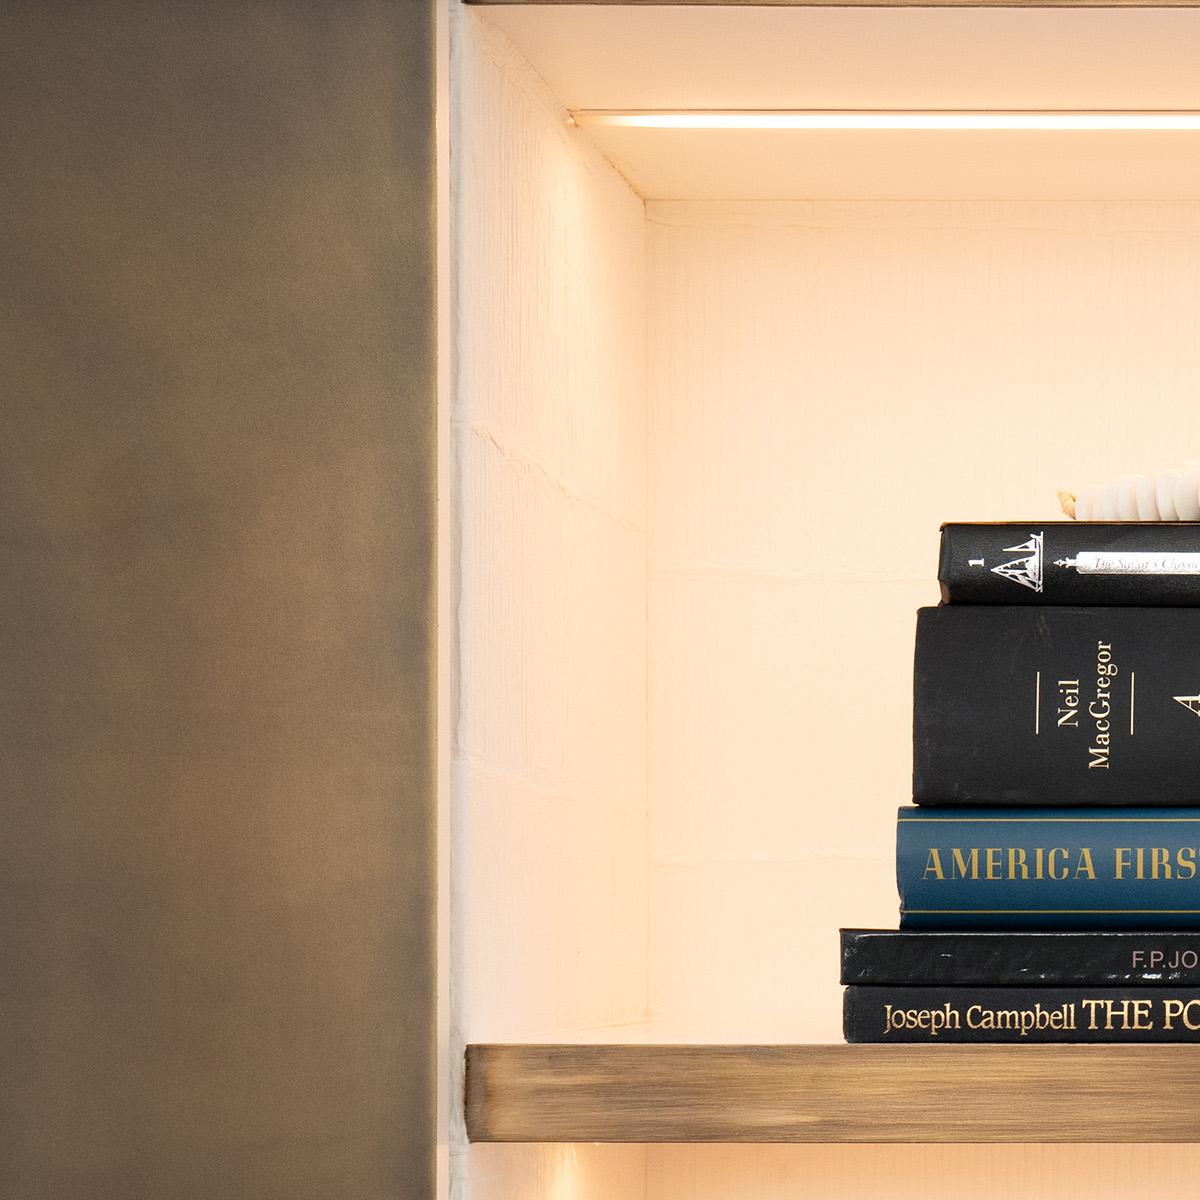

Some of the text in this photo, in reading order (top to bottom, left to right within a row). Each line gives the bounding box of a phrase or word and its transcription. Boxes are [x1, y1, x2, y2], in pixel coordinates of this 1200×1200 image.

[1058, 679, 1079, 727] Neil
[1088, 640, 1118, 769] MacGregor
[1172, 694, 1200, 717] A
[922, 847, 1098, 880] AMERICA
[883, 1003, 1077, 1036] Joseph Campbell
[1081, 999, 1154, 1030] THE
